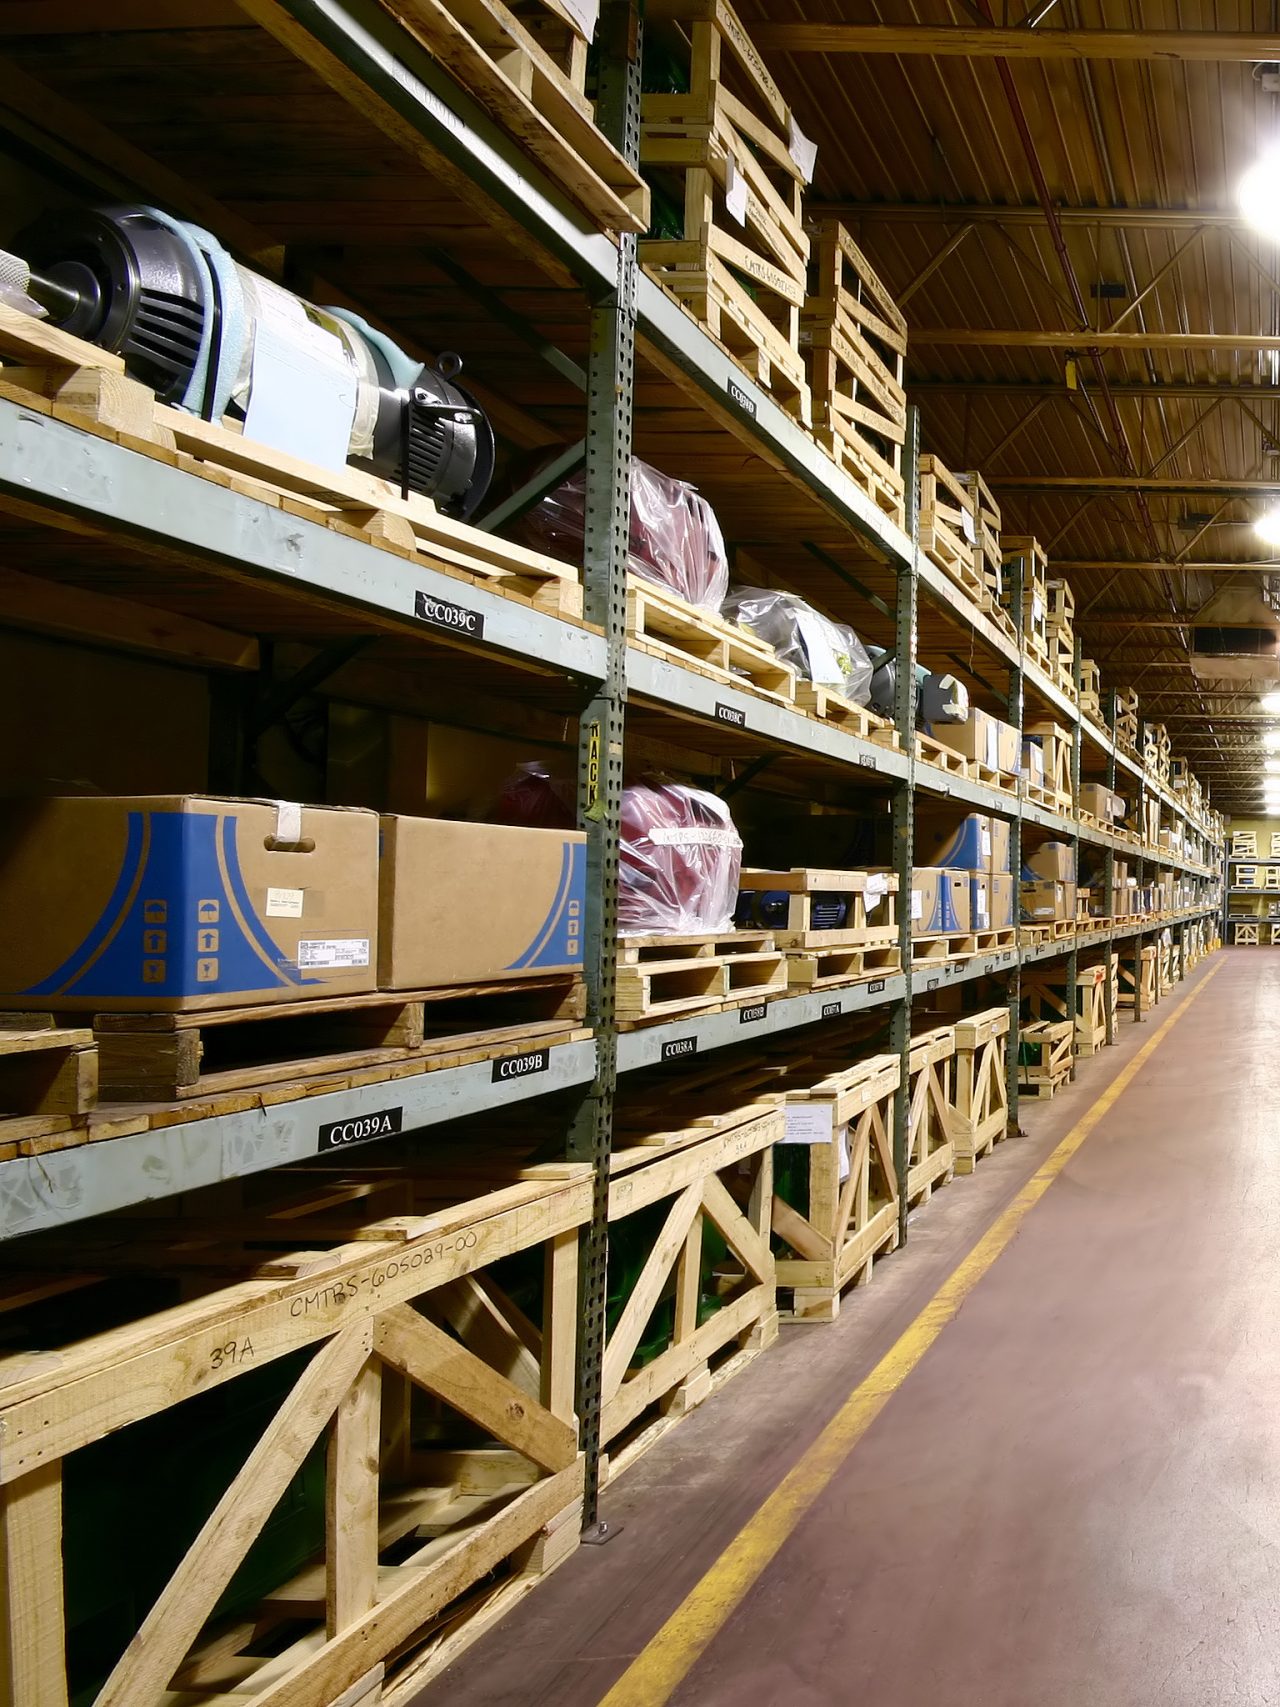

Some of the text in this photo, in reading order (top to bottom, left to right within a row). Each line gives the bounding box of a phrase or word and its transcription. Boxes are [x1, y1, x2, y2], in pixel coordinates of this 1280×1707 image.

[424, 602, 476, 631] CC039C
[500, 1054, 543, 1077] CC039B
[330, 1115, 393, 1145] CC039A
[210, 1336, 256, 1370] 39A
